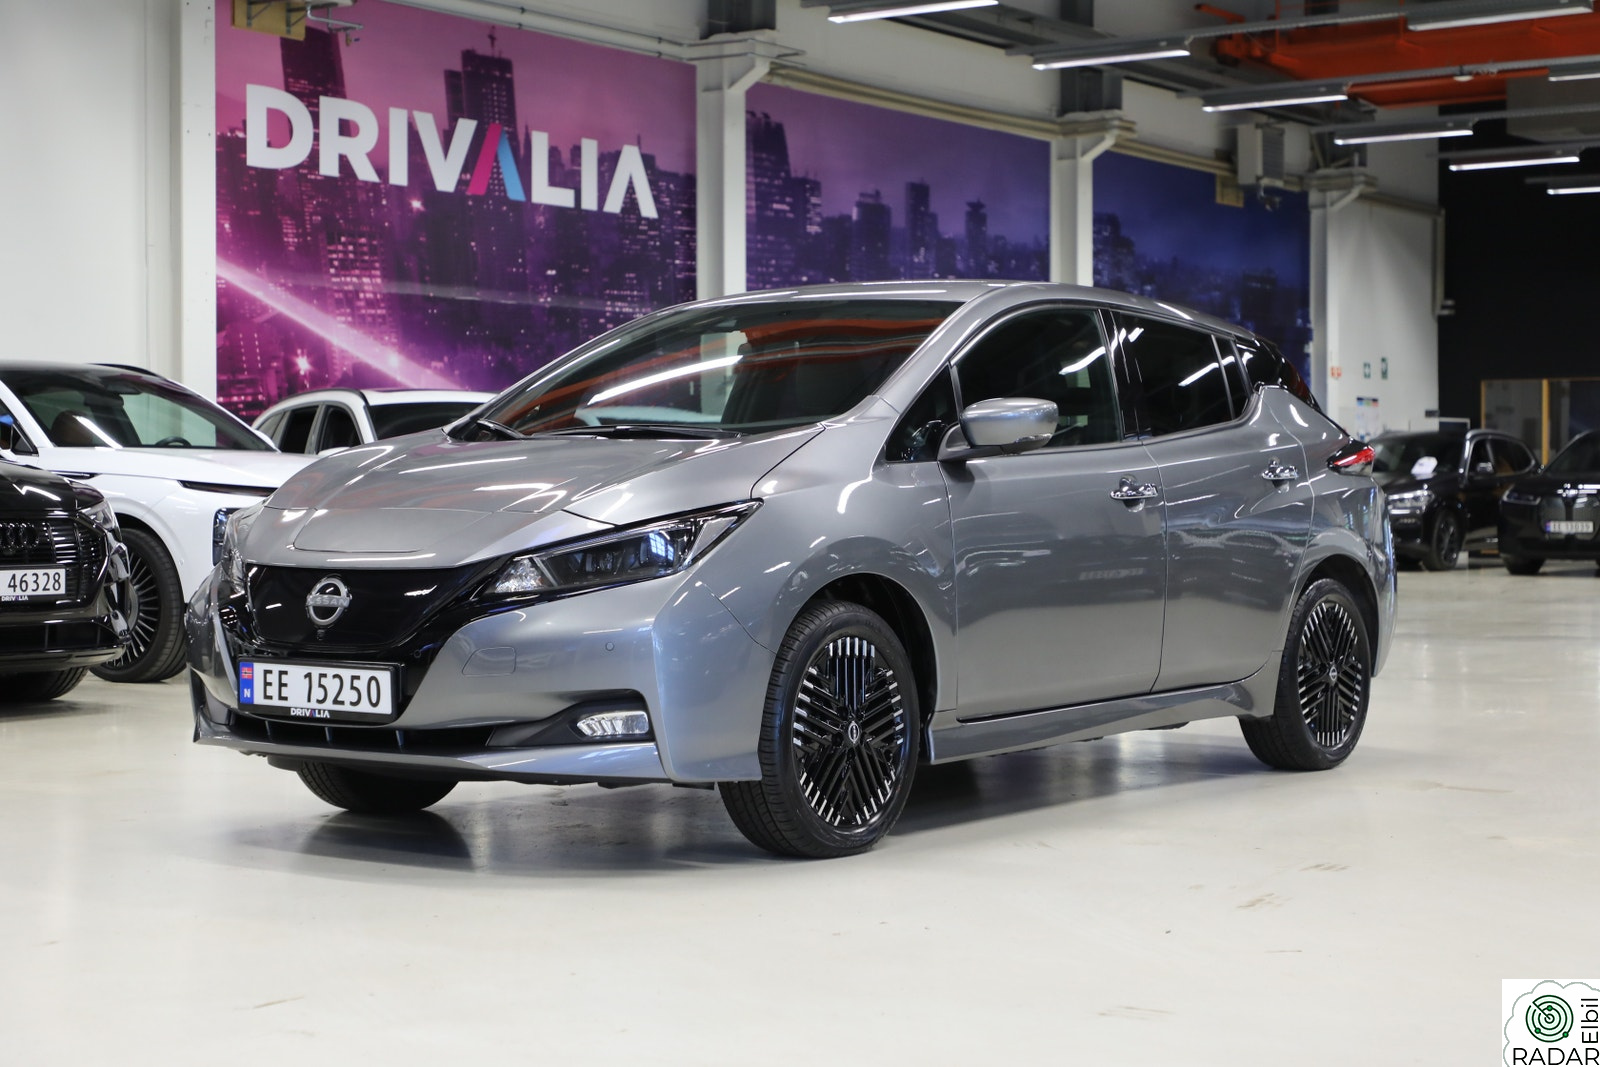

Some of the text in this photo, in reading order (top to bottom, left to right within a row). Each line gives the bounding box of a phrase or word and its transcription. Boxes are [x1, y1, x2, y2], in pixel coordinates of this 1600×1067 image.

[246, 84, 659, 219] DRIVALIA
[7, 571, 61, 593] 46328
[243, 688, 251, 698] N
[263, 669, 381, 708] EE 15250
[290, 707, 330, 718] DRIVALIA
